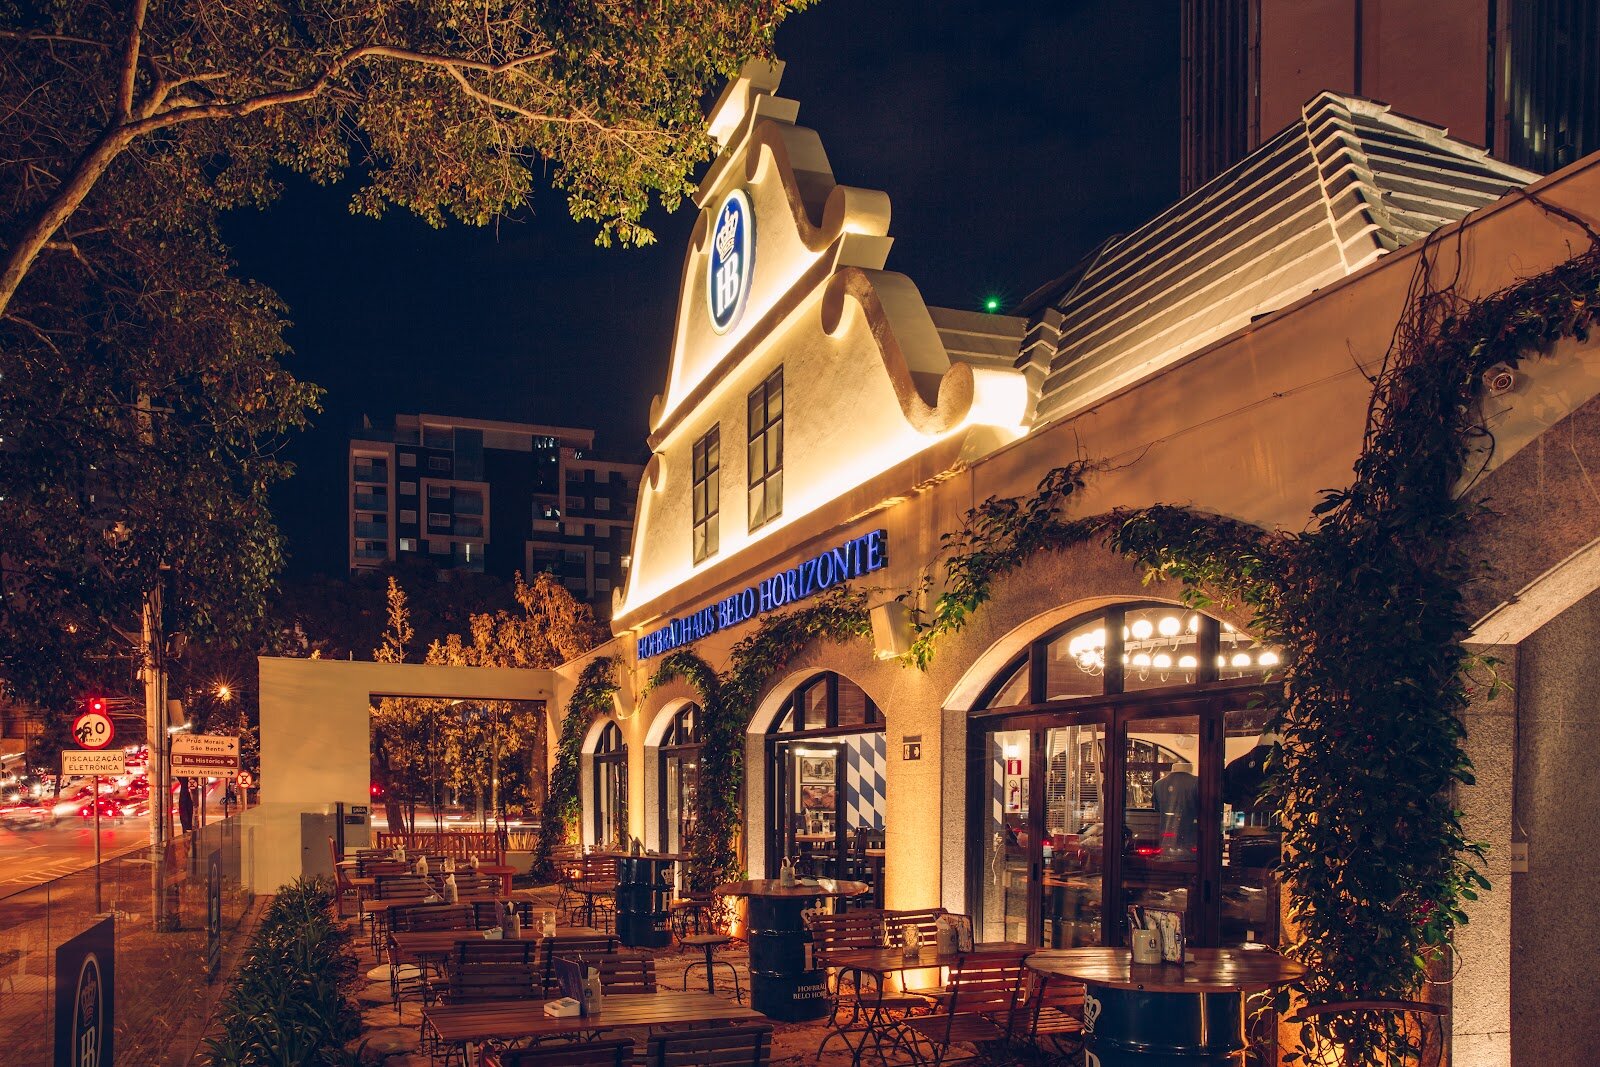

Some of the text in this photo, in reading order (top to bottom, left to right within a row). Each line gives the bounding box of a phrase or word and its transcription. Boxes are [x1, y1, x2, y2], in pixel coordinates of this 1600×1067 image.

[716, 251, 739, 318] HB
[718, 586, 759, 629] BELO
[759, 529, 888, 613] HORIZONTE
[83, 721, 105, 735] 60
[64, 754, 123, 762] FISCALIZAÇÃO
[68, 763, 119, 771] ELETRÔNICA
